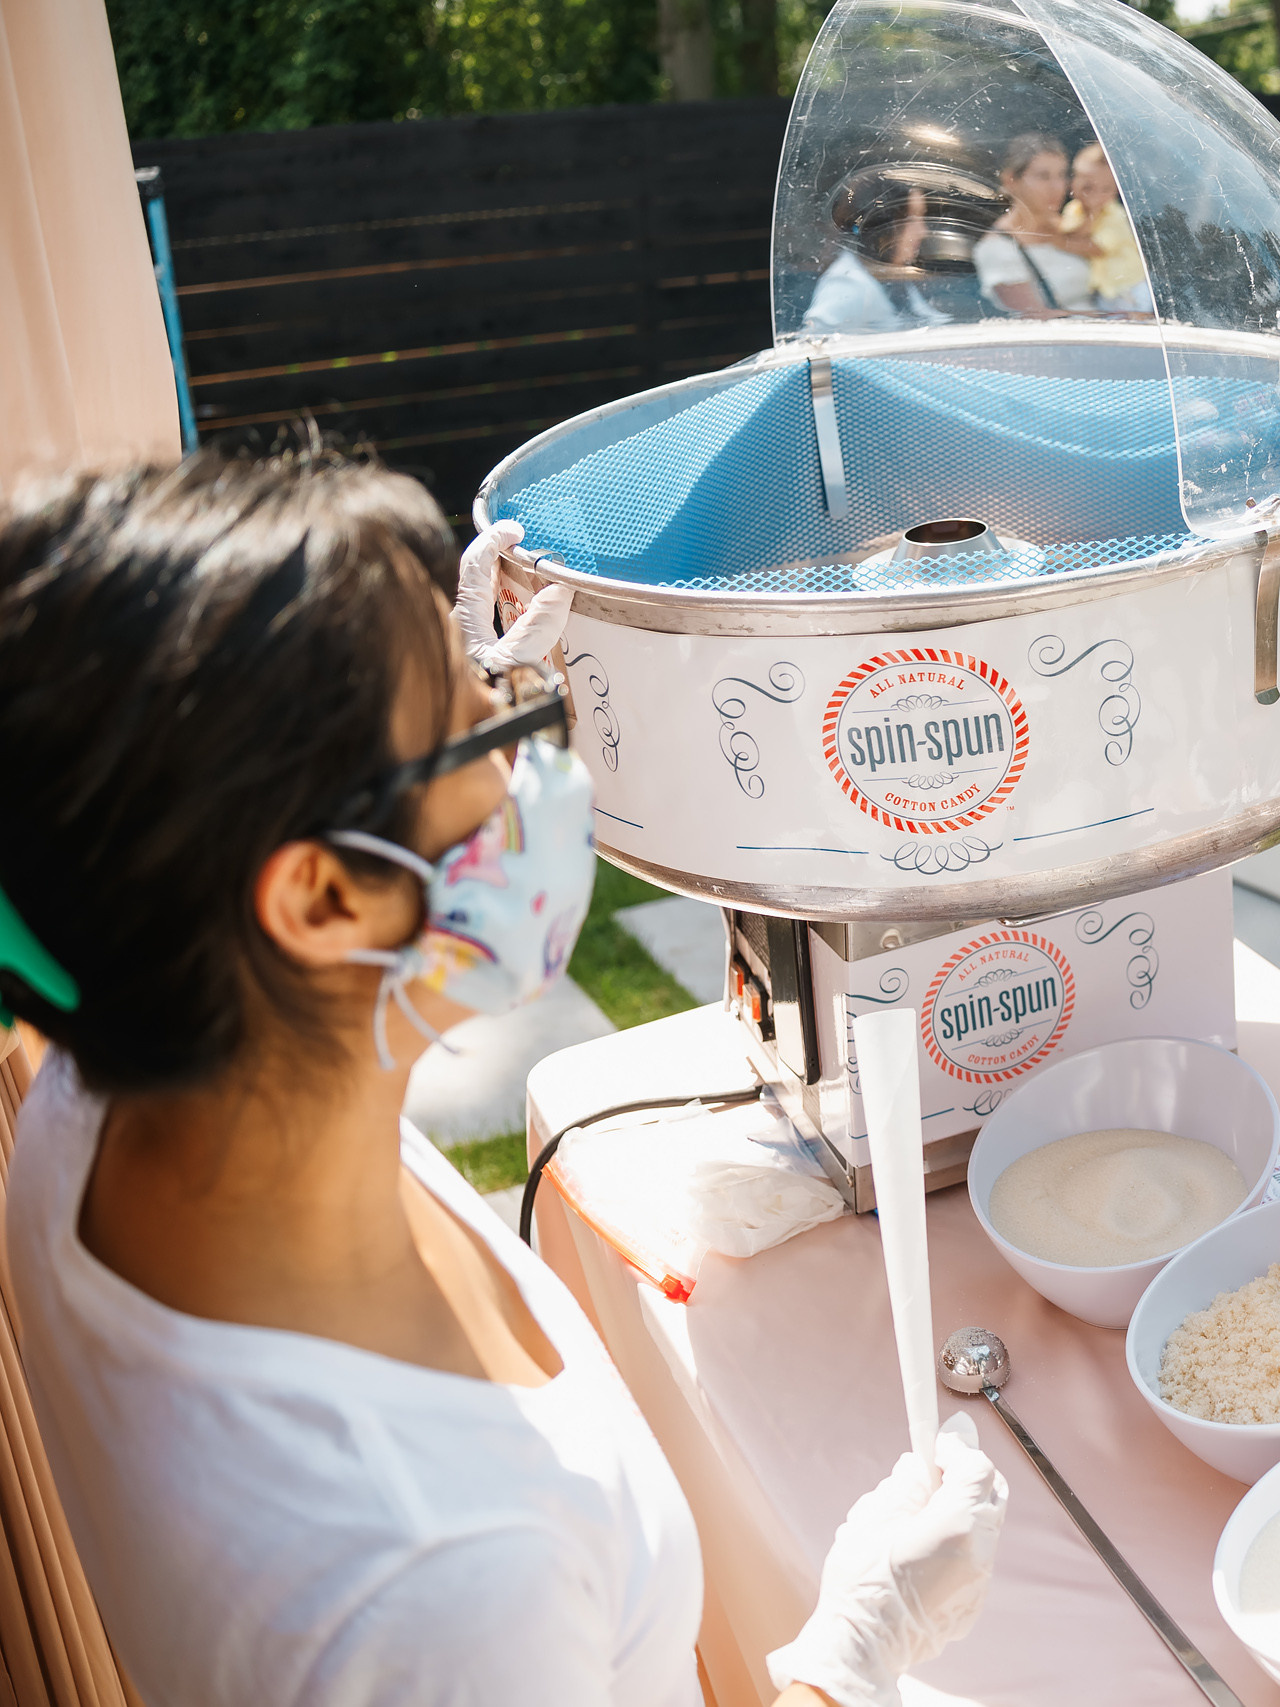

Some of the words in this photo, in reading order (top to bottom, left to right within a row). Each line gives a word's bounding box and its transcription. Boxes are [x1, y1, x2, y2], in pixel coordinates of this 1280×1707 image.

[869, 678, 894, 699] ALL
[899, 672, 965, 691] NATURAL
[847, 712, 1005, 772] spin-spun
[884, 792, 936, 812] COTTON
[940, 784, 981, 810] CANDY
[958, 963, 977, 981] ALL
[979, 950, 1029, 965] NATURAL
[940, 977, 1057, 1041] spin-spun
[967, 1054, 1007, 1066] COTTON
[1009, 1034, 1040, 1060] CANDY
